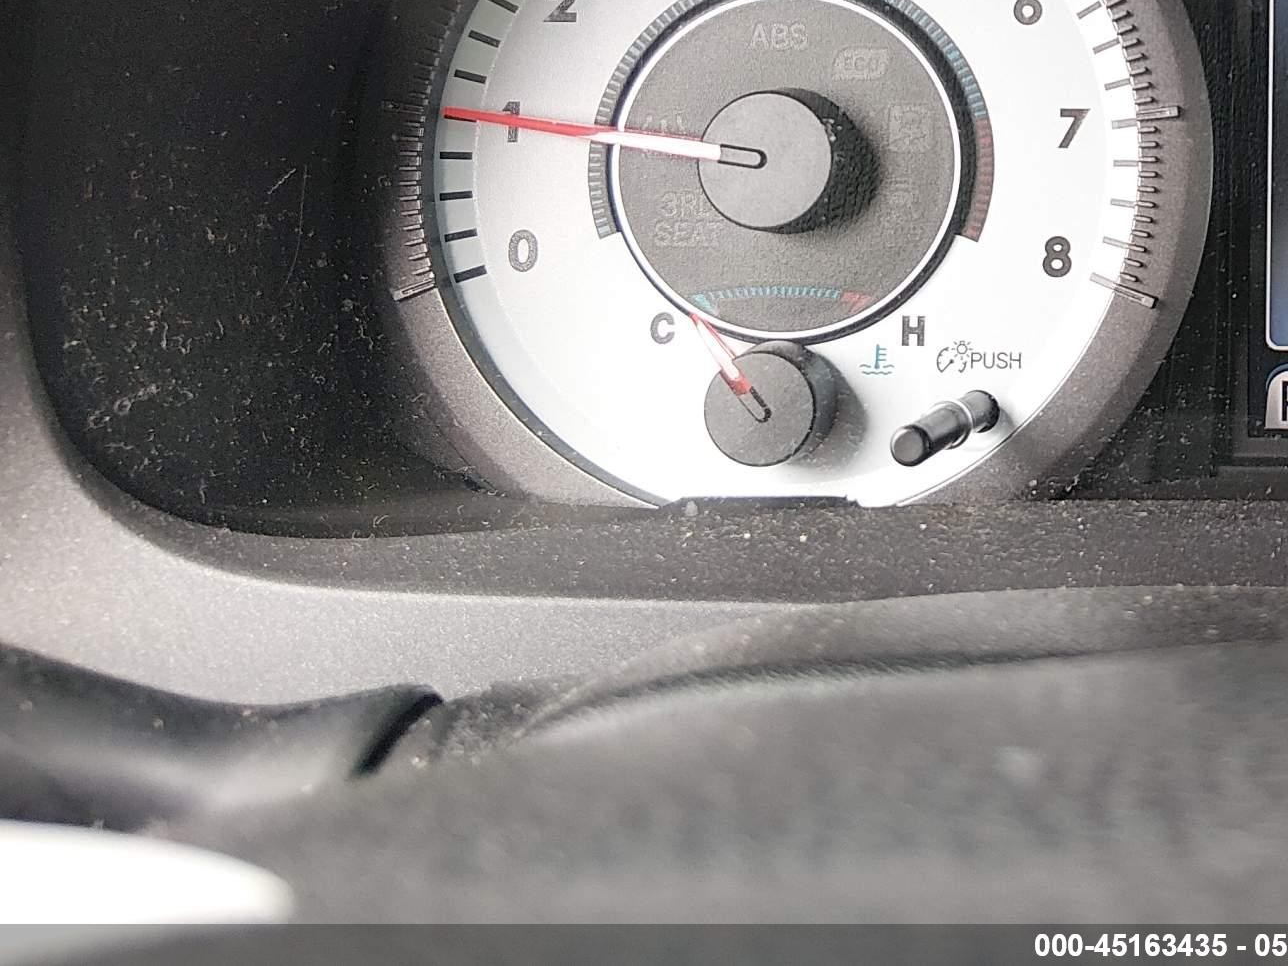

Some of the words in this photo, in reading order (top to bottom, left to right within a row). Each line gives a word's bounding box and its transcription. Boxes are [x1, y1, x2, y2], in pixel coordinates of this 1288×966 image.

[1058, 109, 1089, 149] 7
[508, 229, 538, 272] 0
[1042, 235, 1073, 277] 8
[650, 313, 675, 344] C
[901, 316, 925, 346] H
[970, 352, 1022, 370] PUSH
